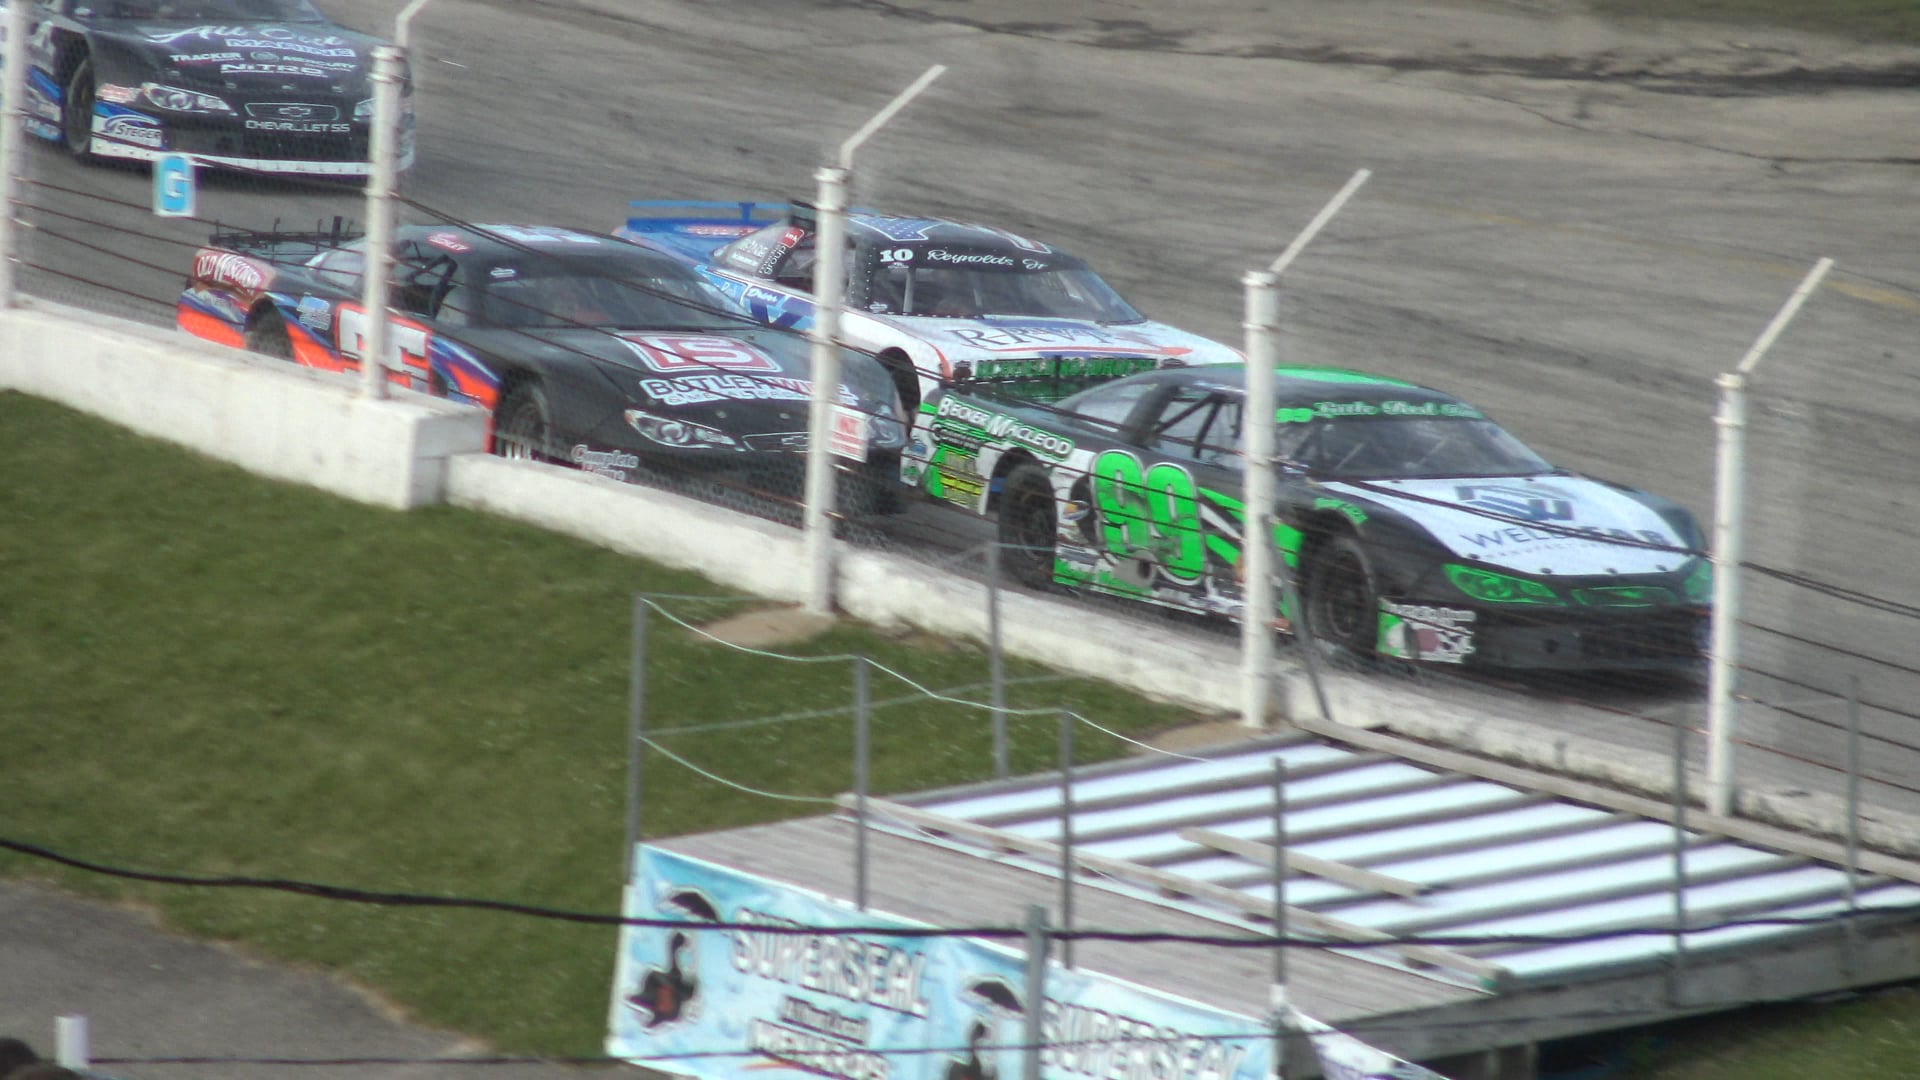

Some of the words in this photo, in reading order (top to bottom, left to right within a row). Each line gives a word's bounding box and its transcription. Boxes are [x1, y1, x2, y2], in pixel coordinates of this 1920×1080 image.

[169, 52, 242, 62] TRACKER
[115, 123, 162, 140] STEGER
[245, 119, 326, 133] CHEVRLET
[331, 123, 350, 133] SS
[879, 249, 914, 263] 10
[927, 249, 1014, 267] Reynolds
[937, 397, 991, 426] BECKER
[1093, 449, 1205, 586] 99
[733, 905, 930, 1020] SUPERSEAL
